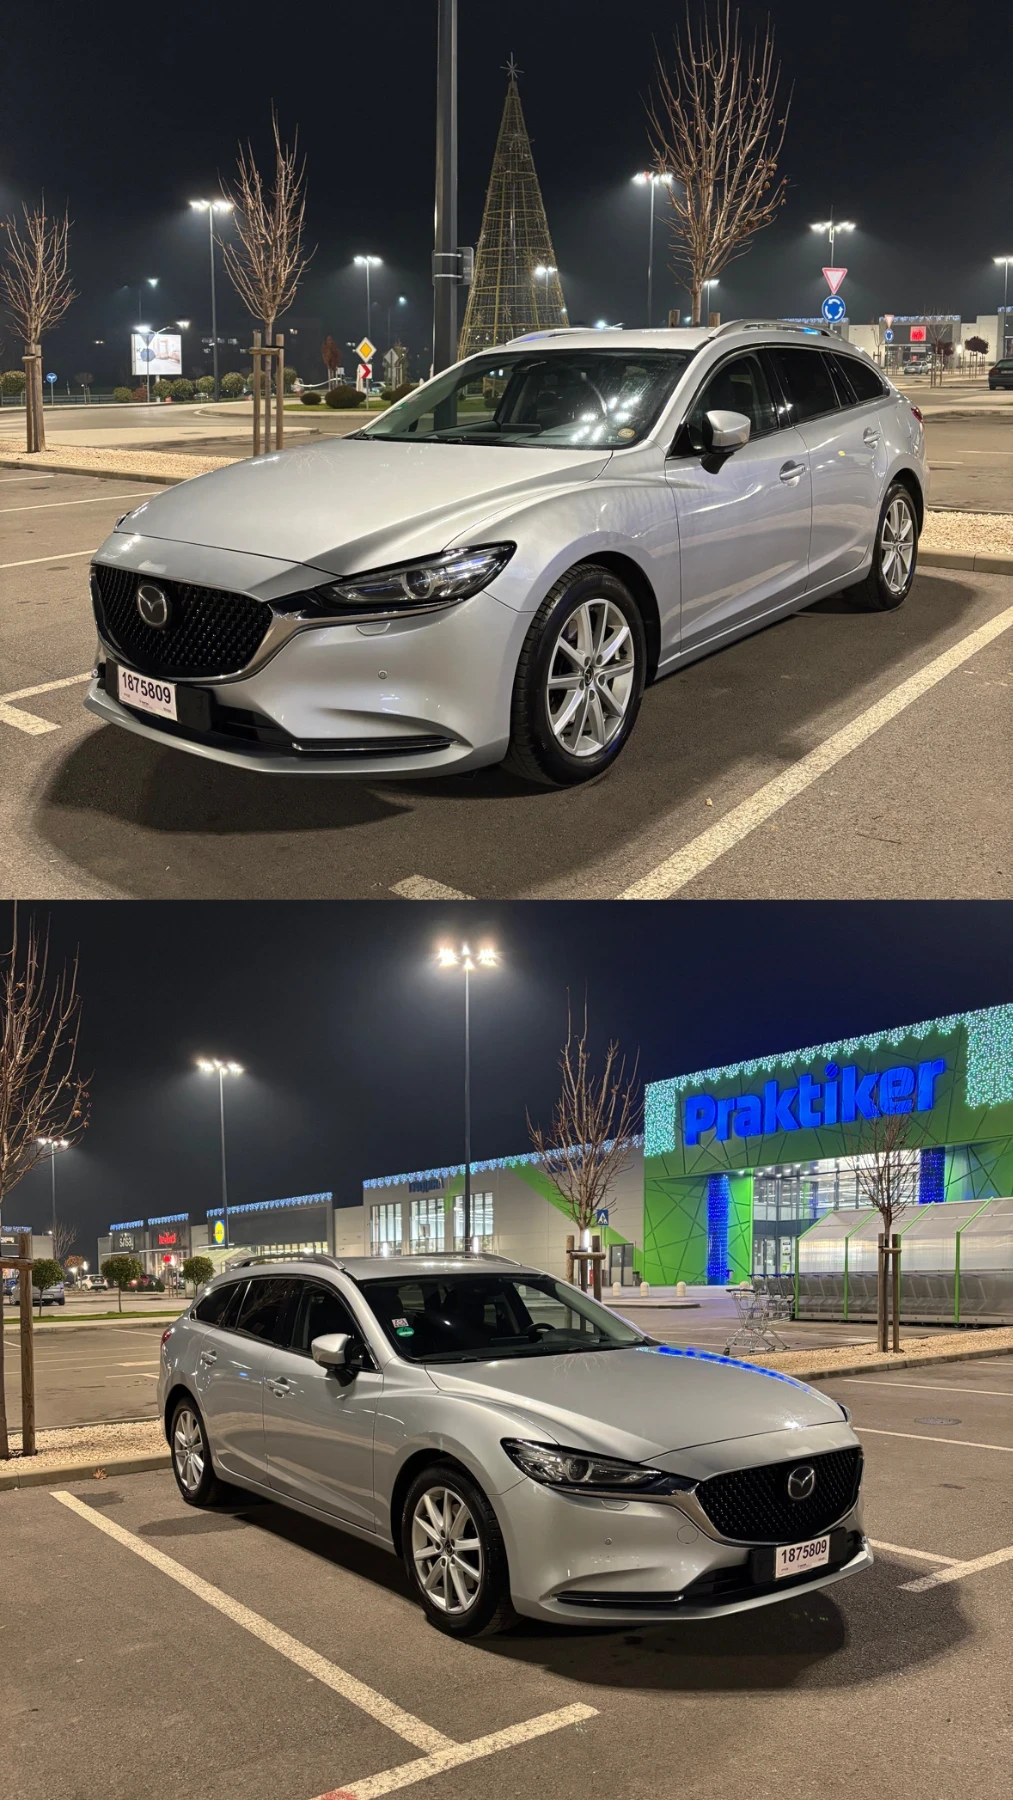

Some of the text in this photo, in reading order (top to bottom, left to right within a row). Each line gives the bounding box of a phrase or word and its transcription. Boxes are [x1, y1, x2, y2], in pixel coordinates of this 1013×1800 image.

[122, 672, 171, 704] 1875809
[685, 1059, 946, 1146] Praktiker
[781, 1539, 827, 1564] 1875809
